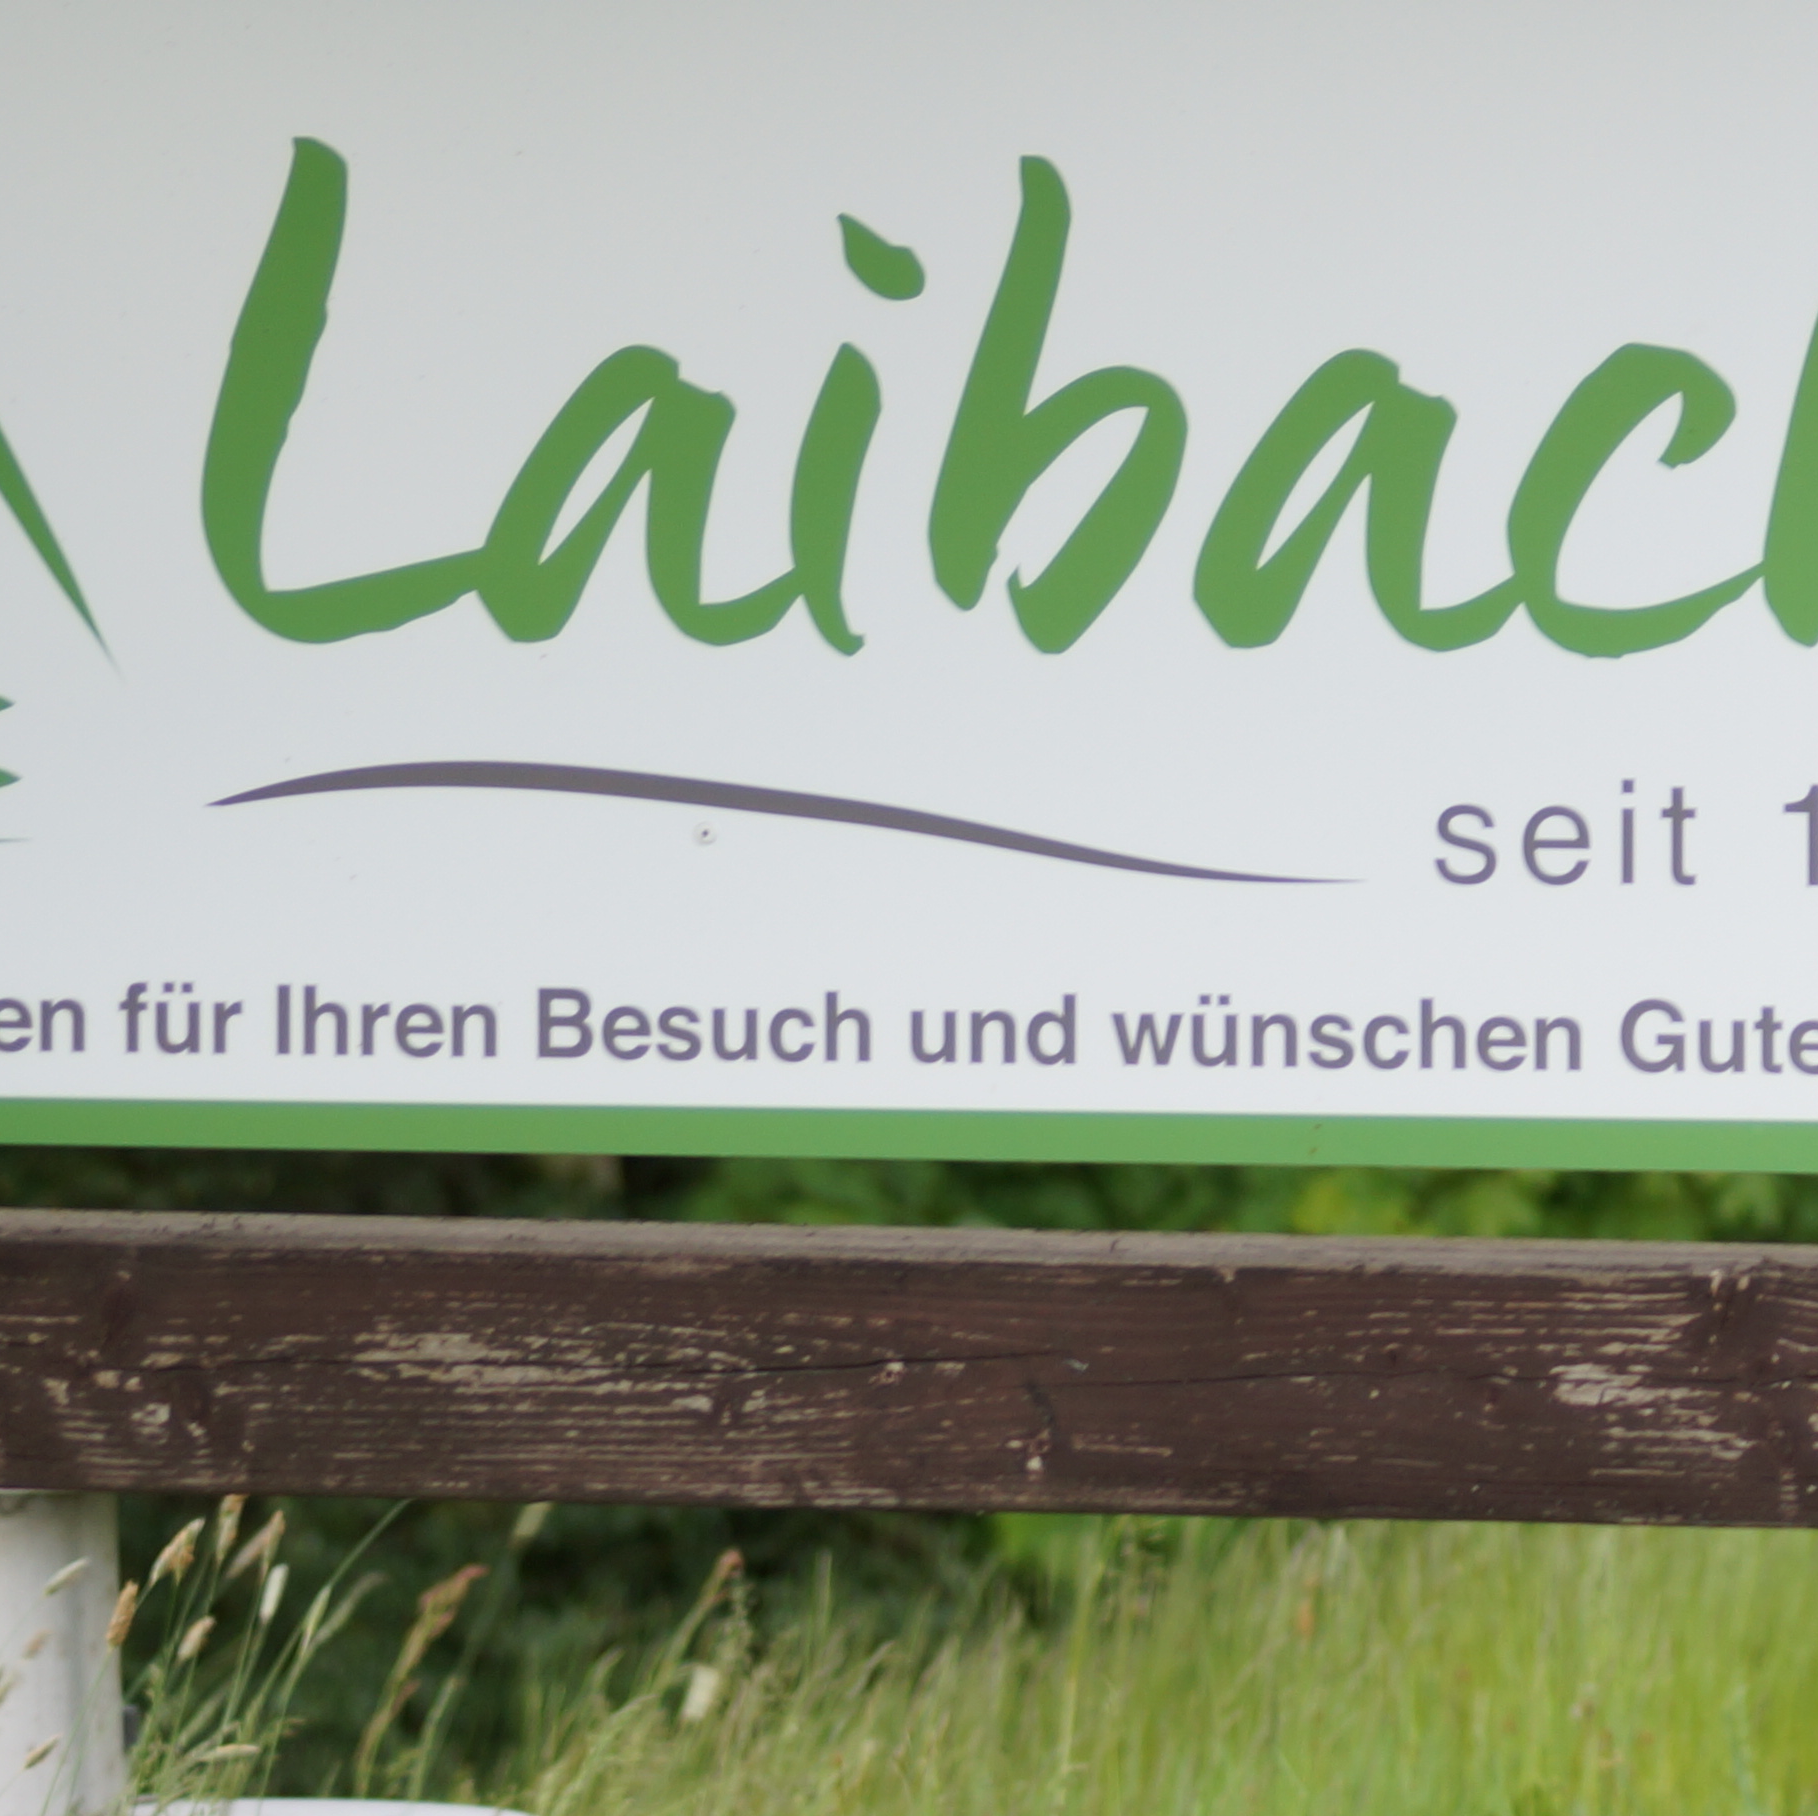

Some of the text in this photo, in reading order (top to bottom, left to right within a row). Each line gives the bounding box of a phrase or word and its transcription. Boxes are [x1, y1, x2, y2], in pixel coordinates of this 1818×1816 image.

[1435, 780, 1696, 887] seit
[119, 982, 243, 1055] für
[276, 984, 498, 1058] Ihren
[537, 987, 871, 1064] Besuch
[910, 993, 1077, 1067] und
[1111, 995, 1581, 1073] wünschen
